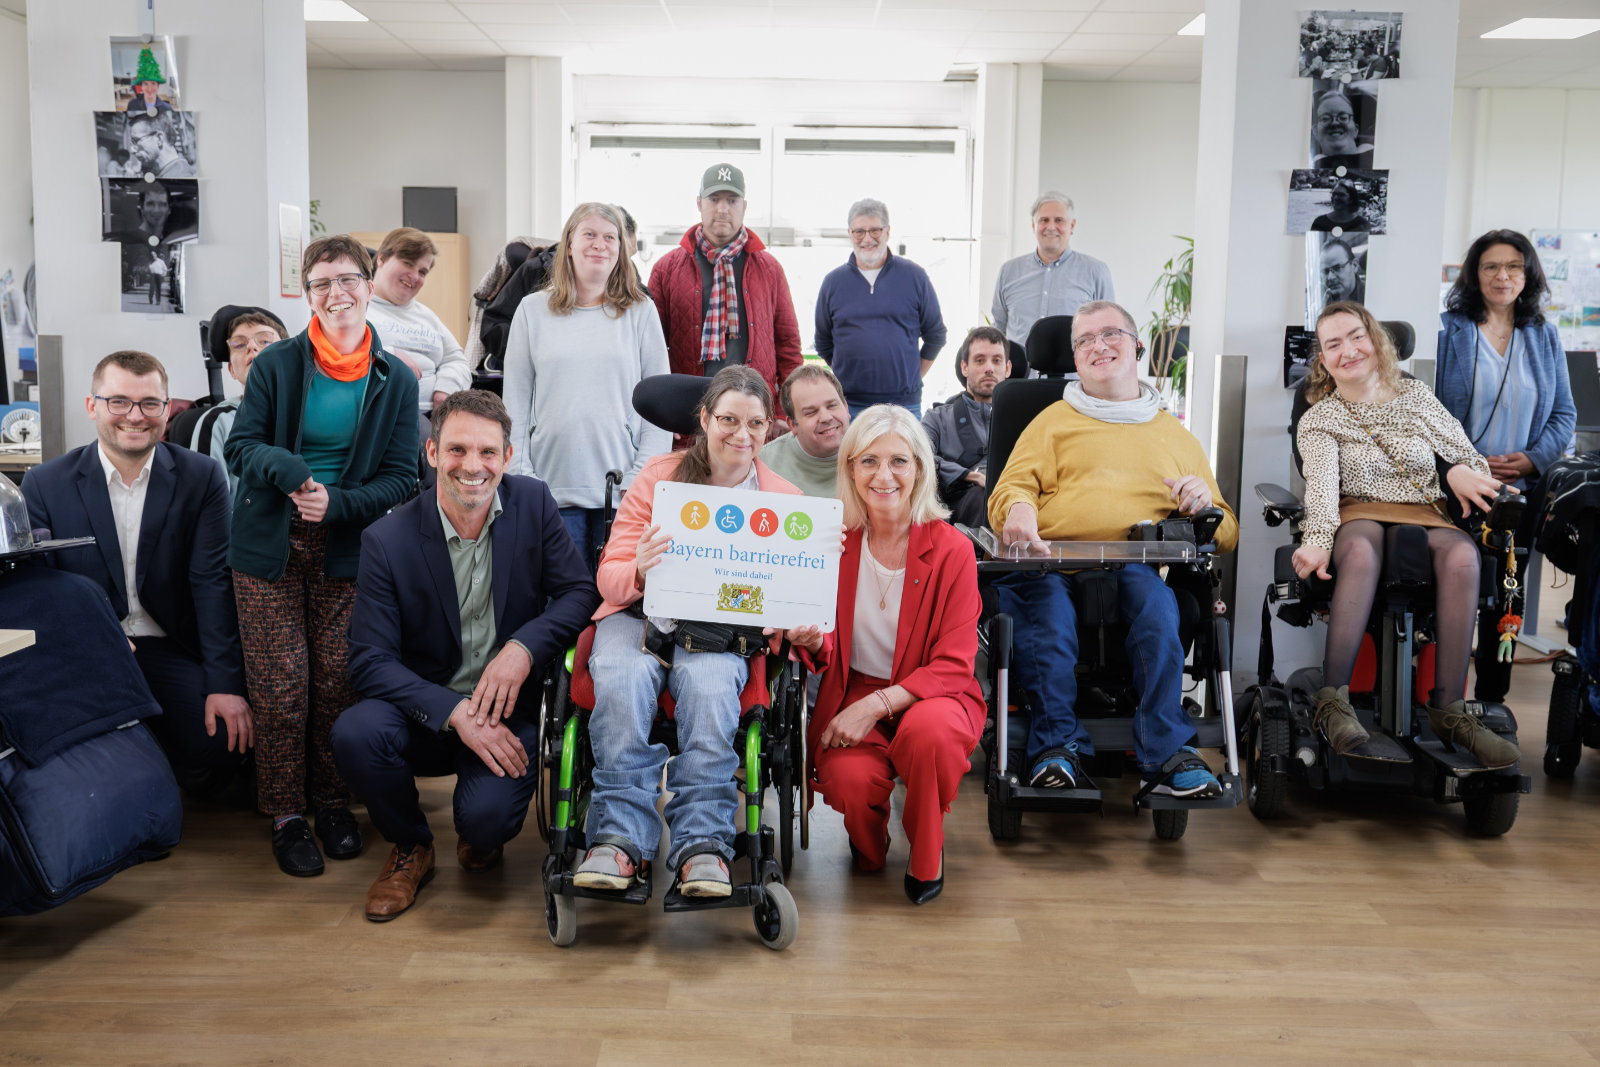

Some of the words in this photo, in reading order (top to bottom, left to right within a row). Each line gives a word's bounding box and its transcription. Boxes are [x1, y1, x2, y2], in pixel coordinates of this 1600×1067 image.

[718, 167, 732, 182] NY
[662, 539, 723, 562] Bayern
[729, 543, 825, 570] barrierefrei
[714, 567, 730, 577] Wir
[731, 569, 748, 579] sind
[749, 570, 773, 581] dabei!
